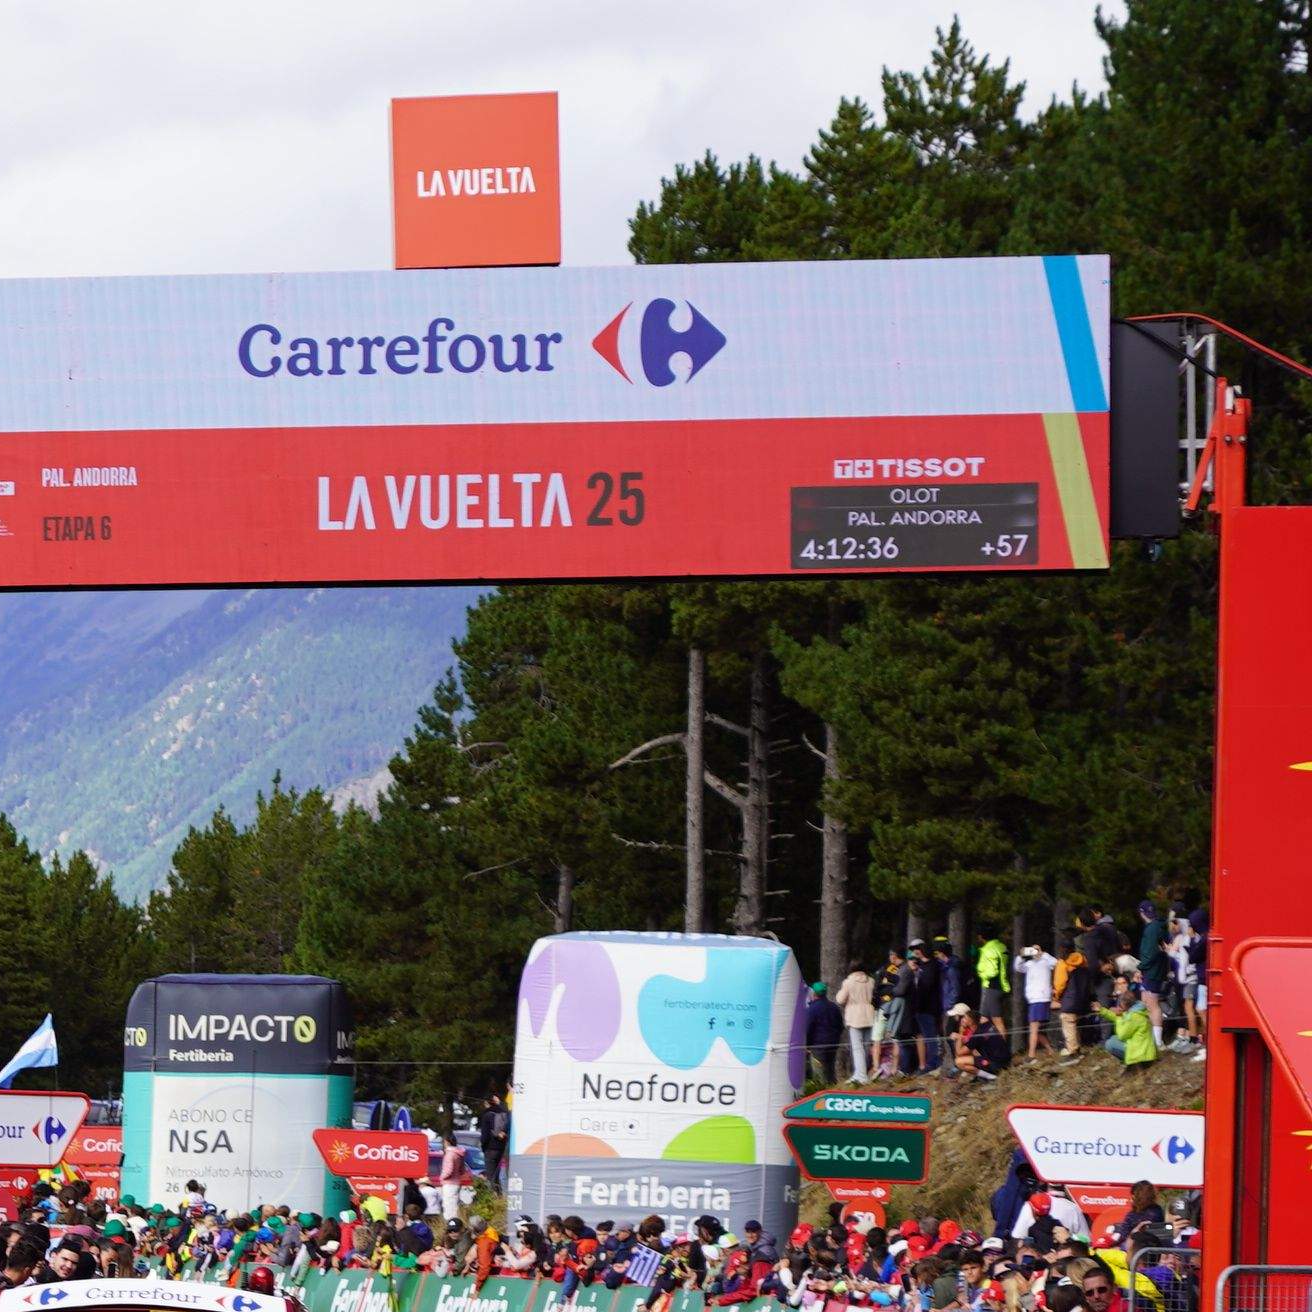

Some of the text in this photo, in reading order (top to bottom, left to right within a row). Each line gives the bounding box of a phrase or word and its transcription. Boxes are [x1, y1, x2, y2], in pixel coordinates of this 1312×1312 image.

[416, 166, 536, 198] LA VUELTA
[237, 316, 564, 379] Carrefour
[73, 465, 138, 487] ANDORRA
[876, 457, 986, 479] TISSOT
[317, 471, 646, 531] LA VUELTA 25
[889, 488, 941, 505] OLOT
[42, 517, 97, 542] ETAPA
[99, 516, 112, 541] 6
[847, 509, 983, 527] PAL. ANDORRA
[800, 534, 1029, 560] 4:12:36 +57
[168, 1048, 234, 1063] Fertiberia
[581, 1073, 738, 1106] Neoforce
[825, 1097, 871, 1112] caser
[167, 1108, 254, 1124] ABONO CE
[578, 1116, 619, 1134] Care
[168, 1129, 234, 1155] NSA
[353, 1143, 420, 1162] Cofidis
[1032, 1135, 1142, 1159] Carrefour
[165, 1165, 229, 1179] Nitrosulfato
[573, 1175, 731, 1212] Fertiberia
[85, 1286, 203, 1304] Carrefour
